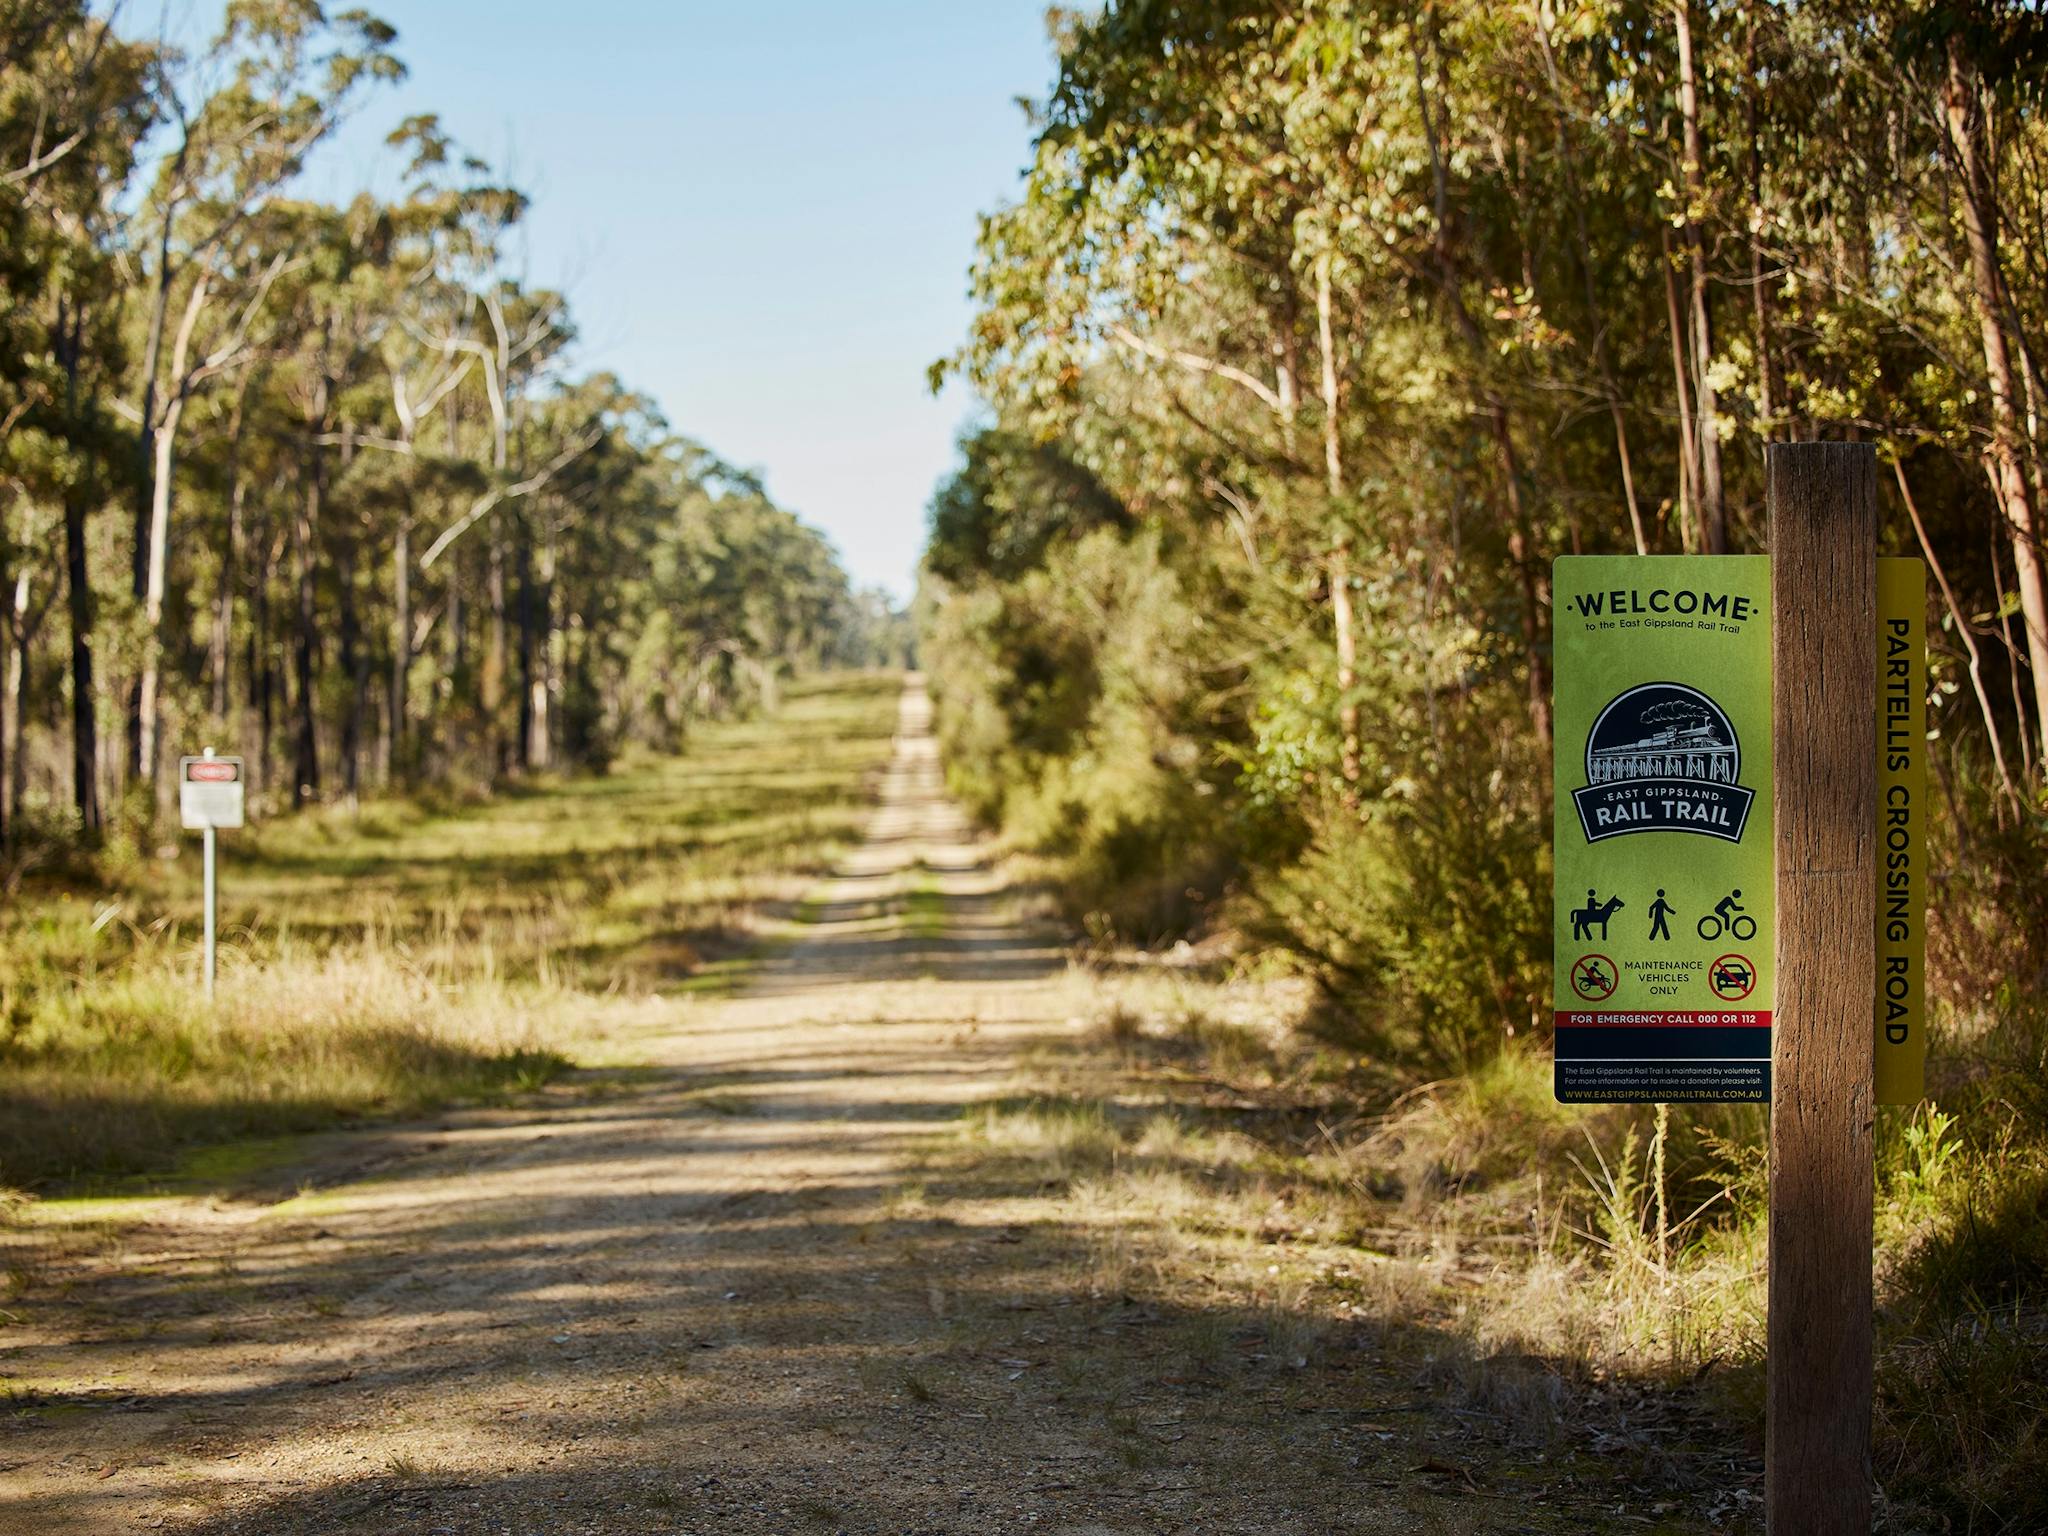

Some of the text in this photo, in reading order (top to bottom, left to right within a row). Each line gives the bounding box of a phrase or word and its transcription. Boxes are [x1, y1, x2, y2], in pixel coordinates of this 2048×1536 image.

[1575, 589, 1750, 621] WELCOME
[1586, 618, 1740, 634] to the East Gippsland Rail Trail
[1608, 788, 1719, 801] EAST GIPPSLAND
[1595, 801, 1731, 827] RAIL TRAIL
[1886, 619, 1910, 1045] PARTELLIS CROSSING ROAD
[1624, 961, 1703, 970] MAINTENANCE
[1638, 974, 1689, 982] VEHICLES
[1649, 986, 1678, 995] ONLY
[1571, 1014, 1756, 1024] FOR EMERGENCY CALL 000 OR 112
[1596, 1067, 1633, 1076] Gippsland
[1713, 1067, 1722, 1076] by
[1721, 1078, 1745, 1086] please
[1565, 1090, 1762, 1098] WWW.EASTGIPPSLANDRAILTRAIL.COM.AU
